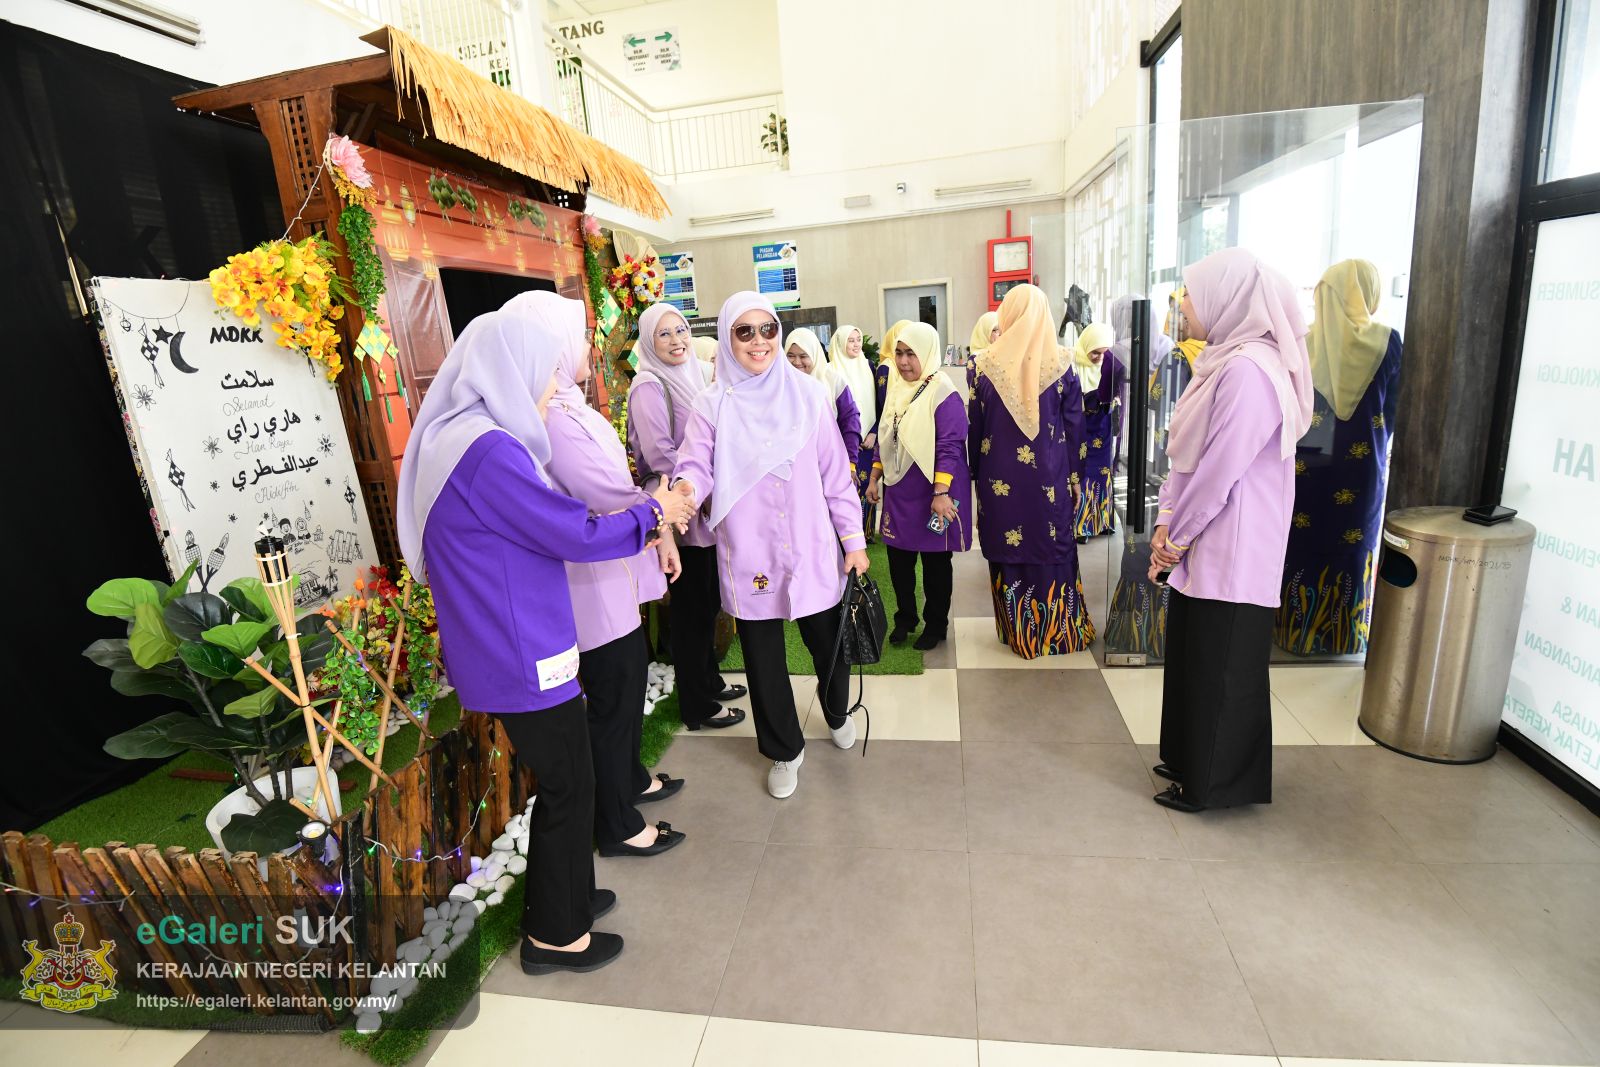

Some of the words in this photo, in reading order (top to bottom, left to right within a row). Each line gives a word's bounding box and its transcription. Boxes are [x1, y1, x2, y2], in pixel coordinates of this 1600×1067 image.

[552, 20, 604, 44] TANG
[210, 326, 264, 344] MDKK
[221, 370, 274, 390] سلامت
[223, 394, 276, 416] Selamat
[264, 408, 301, 437] هاري
